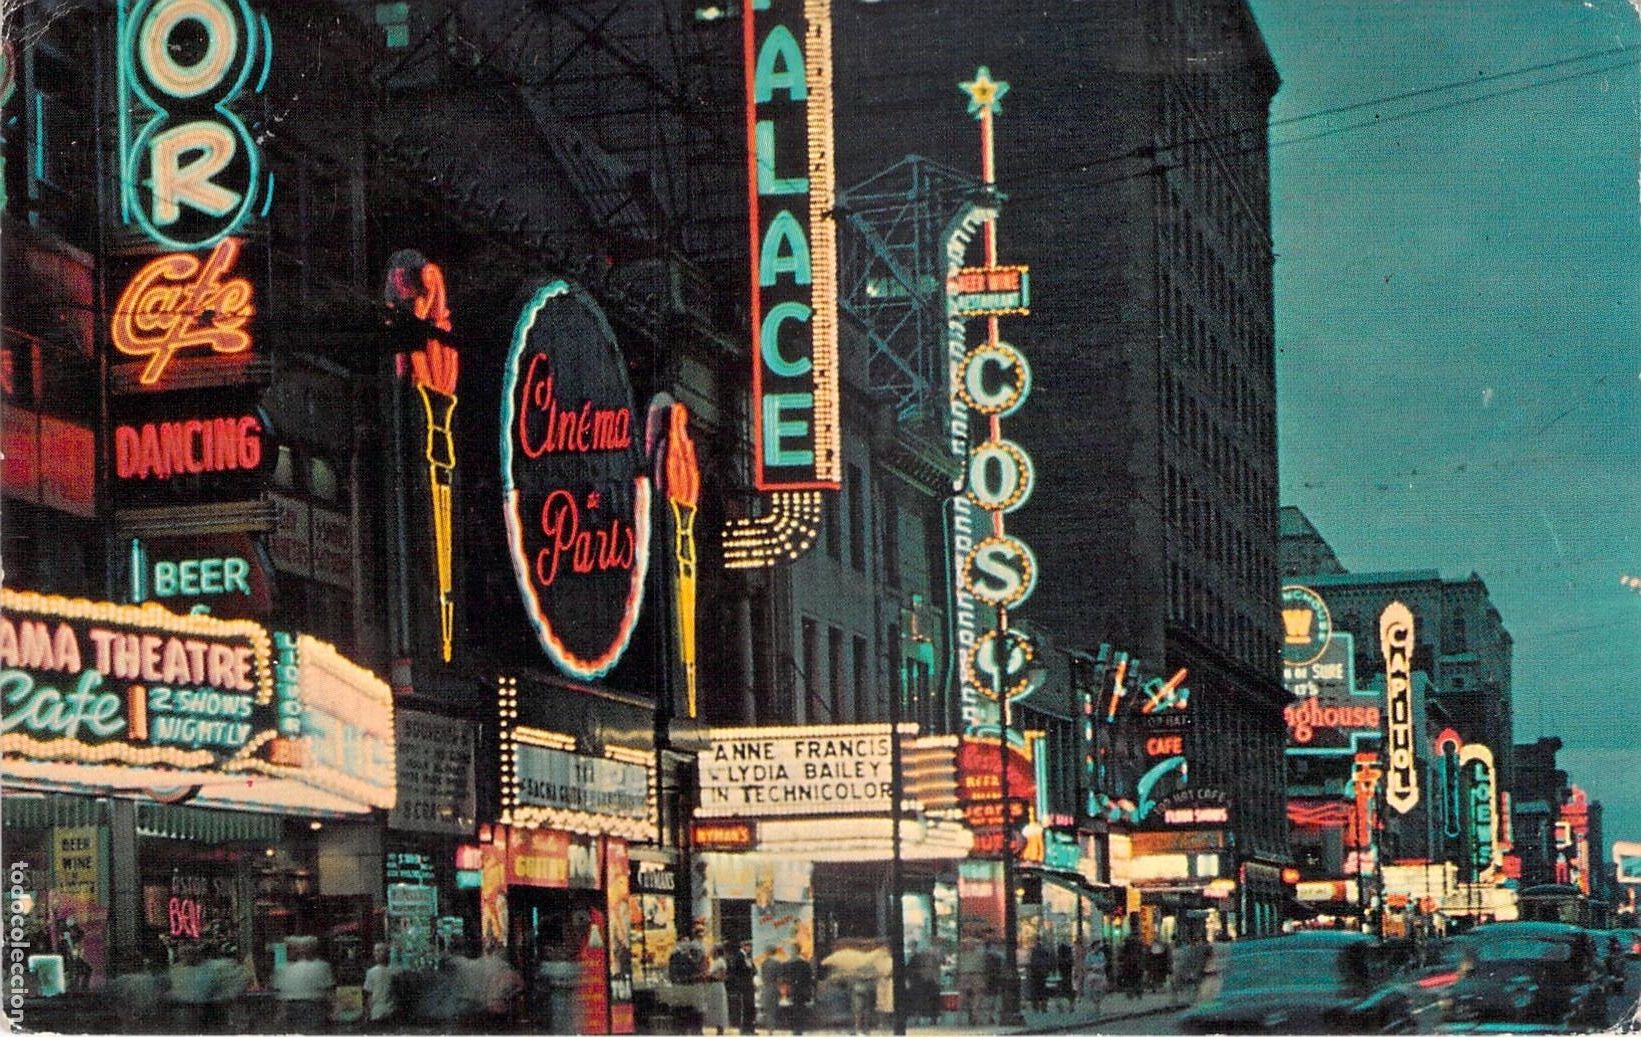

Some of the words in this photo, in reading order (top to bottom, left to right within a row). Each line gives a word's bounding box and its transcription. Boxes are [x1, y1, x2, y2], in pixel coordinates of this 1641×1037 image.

[753, 0, 814, 467] ALACE
[115, 416, 262, 479] DANCING
[537, 489, 635, 586] Paris
[154, 557, 251, 597] BEER
[90, 628, 256, 691] THEATRE
[149, 687, 173, 710] 2
[173, 689, 254, 717] SHOWS
[1385, 621, 1410, 790] CAPITOL
[153, 716, 252, 748] NIGHTLY
[714, 742, 776, 762] ANNE
[795, 738, 889, 760] FRANCIS
[1146, 735, 1183, 756] CAFE
[728, 762, 789, 783] LYDIA
[804, 761, 882, 780] BAILEY
[713, 788, 729, 801] IN
[742, 782, 894, 804] TECHNICOLOR
